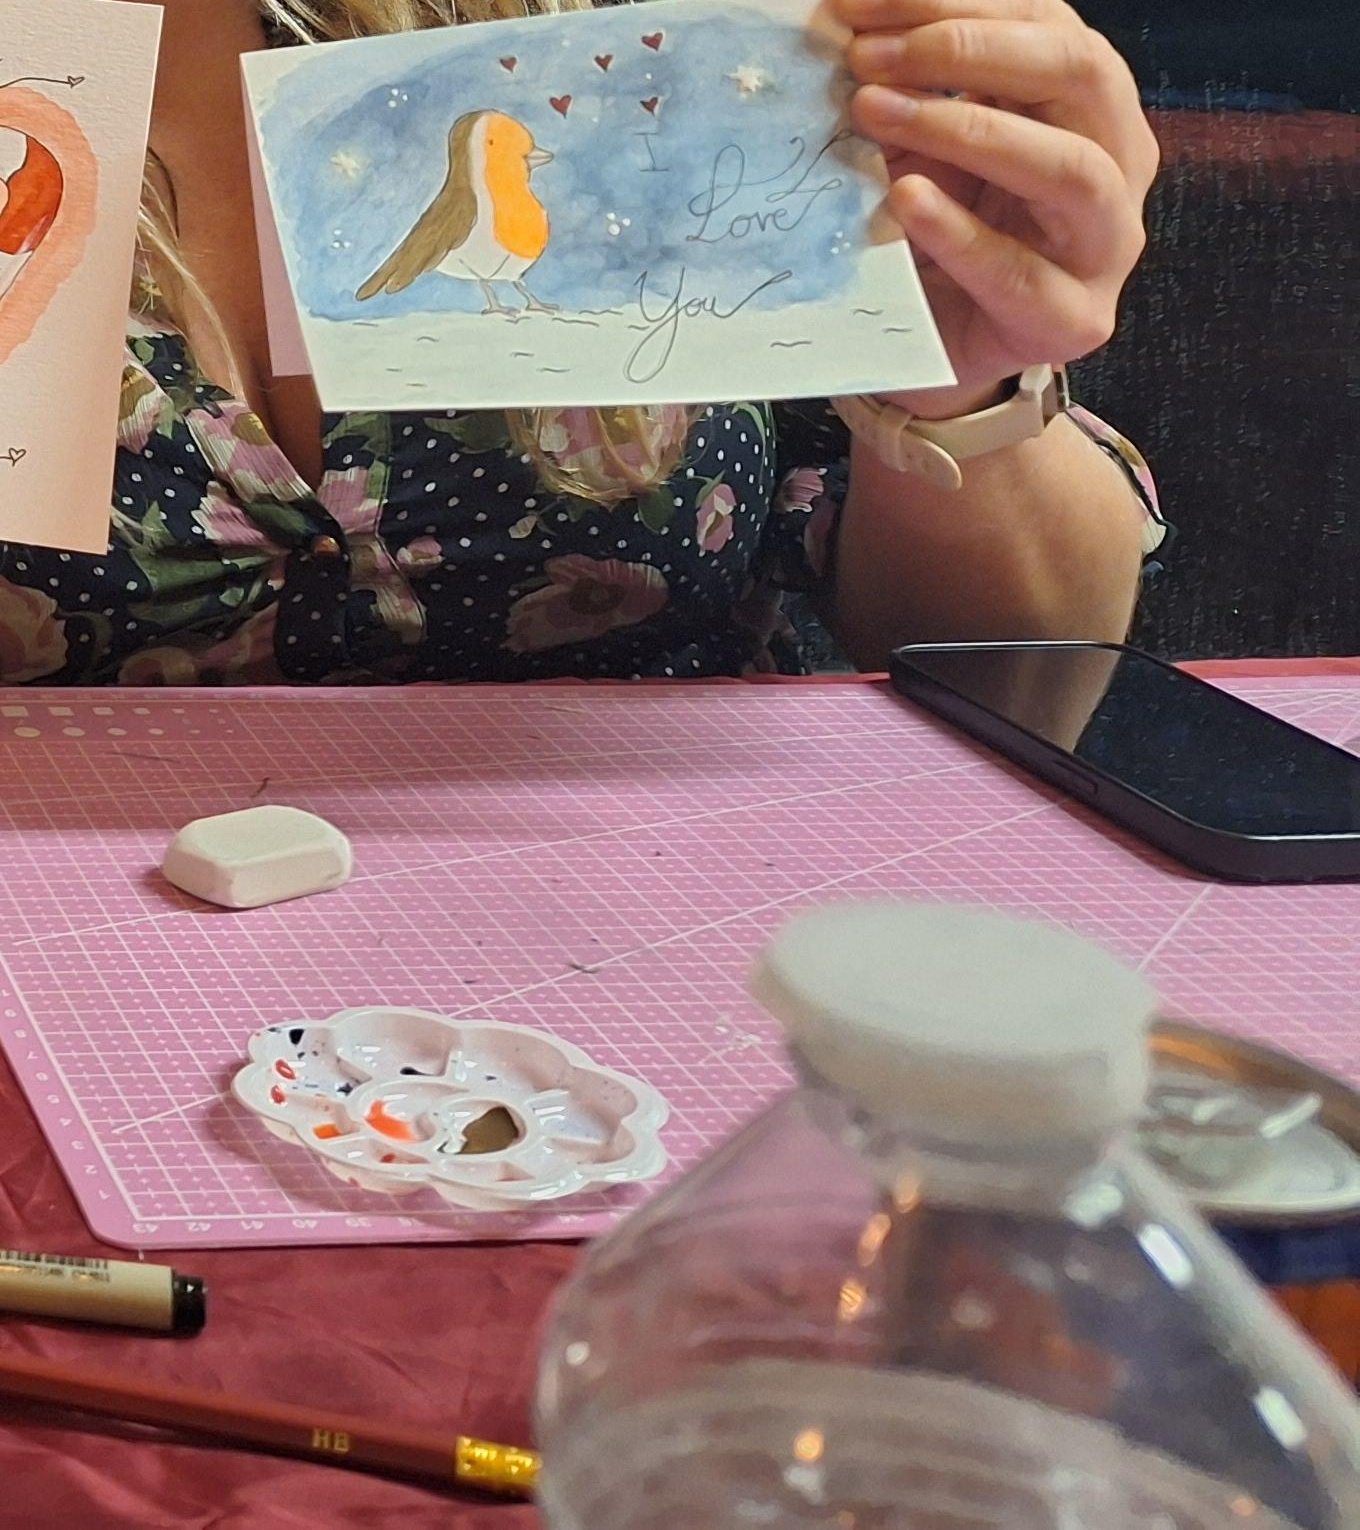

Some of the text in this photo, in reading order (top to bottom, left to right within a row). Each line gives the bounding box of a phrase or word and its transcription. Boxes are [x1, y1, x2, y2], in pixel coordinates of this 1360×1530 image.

[634, 131, 850, 243] I Love
[625, 267, 793, 384] You
[5, 1009, 16, 1017] 9
[14, 1030, 26, 1038] 8
[27, 1051, 38, 1059] 7
[36, 1072, 48, 1080] 6
[47, 1095, 59, 1103] 5
[72, 1141, 84, 1149] 3
[84, 1165, 97, 1173] 2
[98, 1190, 110, 1199] 1
[312, 1428, 351, 1453] HB
